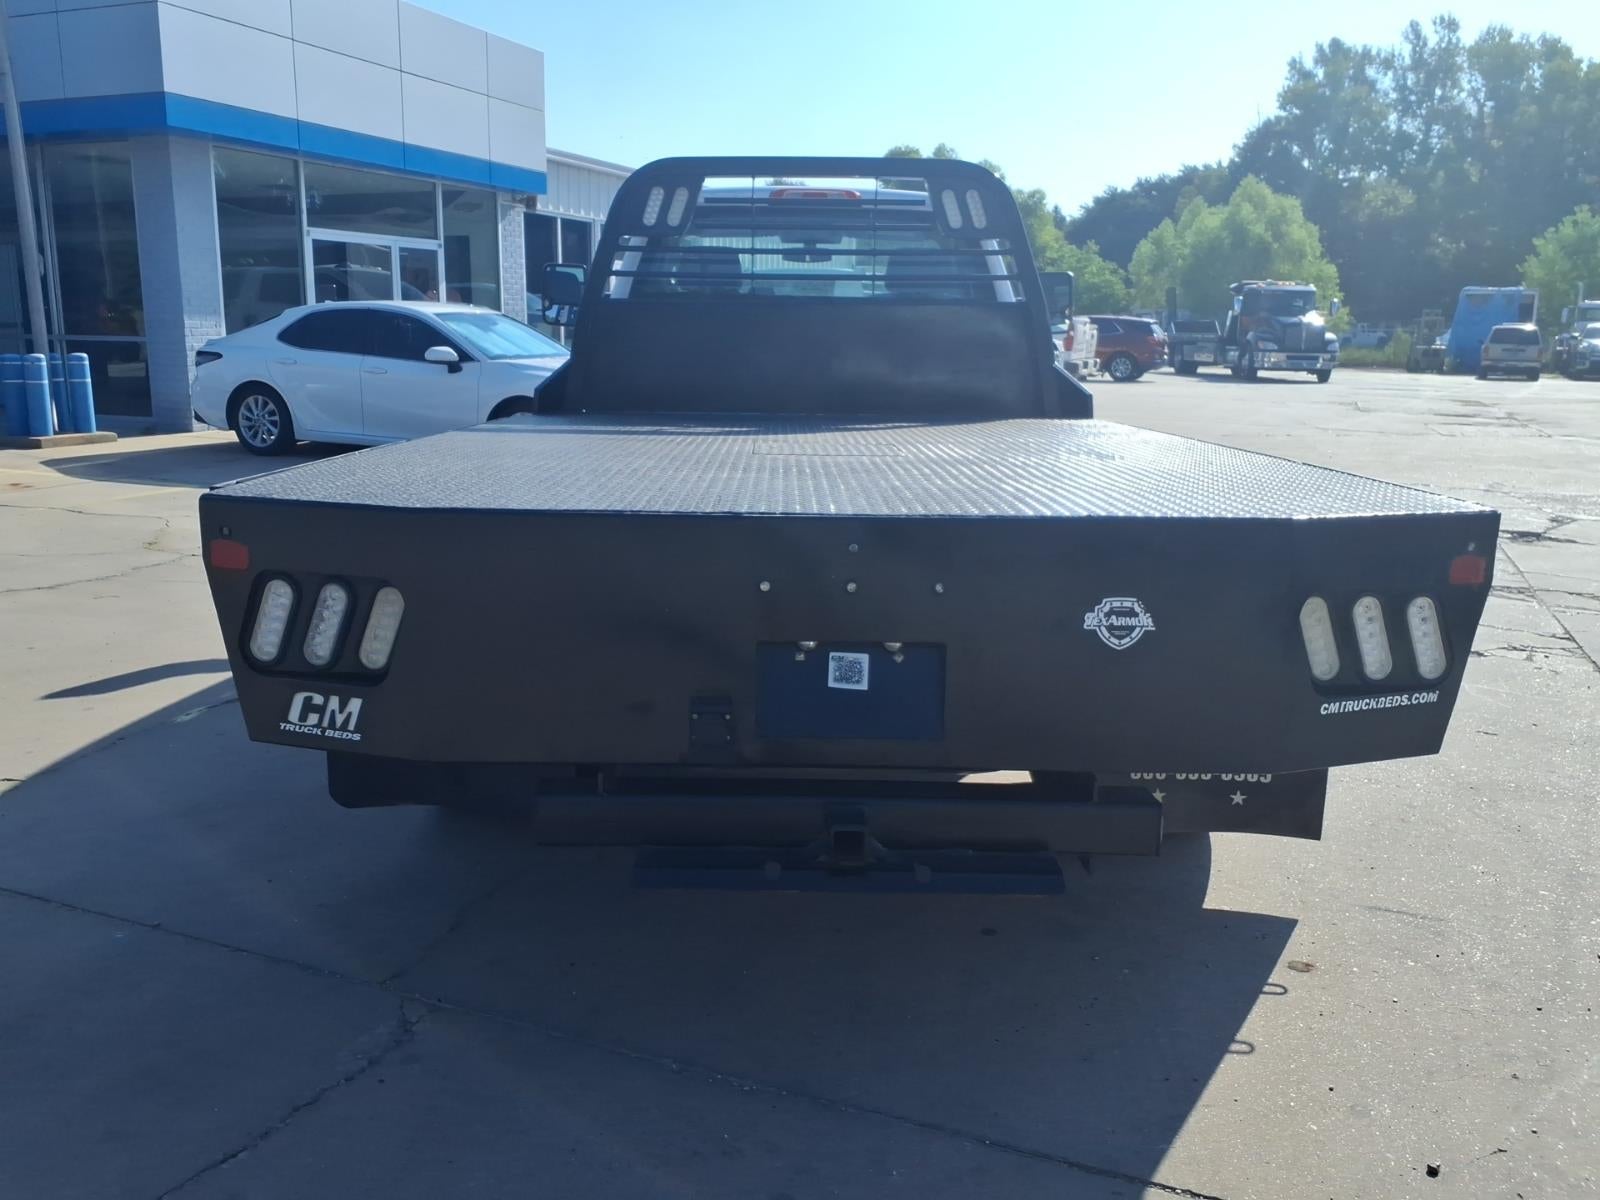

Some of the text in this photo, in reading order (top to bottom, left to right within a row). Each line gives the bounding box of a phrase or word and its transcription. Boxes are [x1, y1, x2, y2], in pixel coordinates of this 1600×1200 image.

[288, 692, 363, 730] CM
[1320, 691, 1439, 715] CMTRUCKBEDS.COM
[279, 722, 361, 740] TRUCK BEDS
